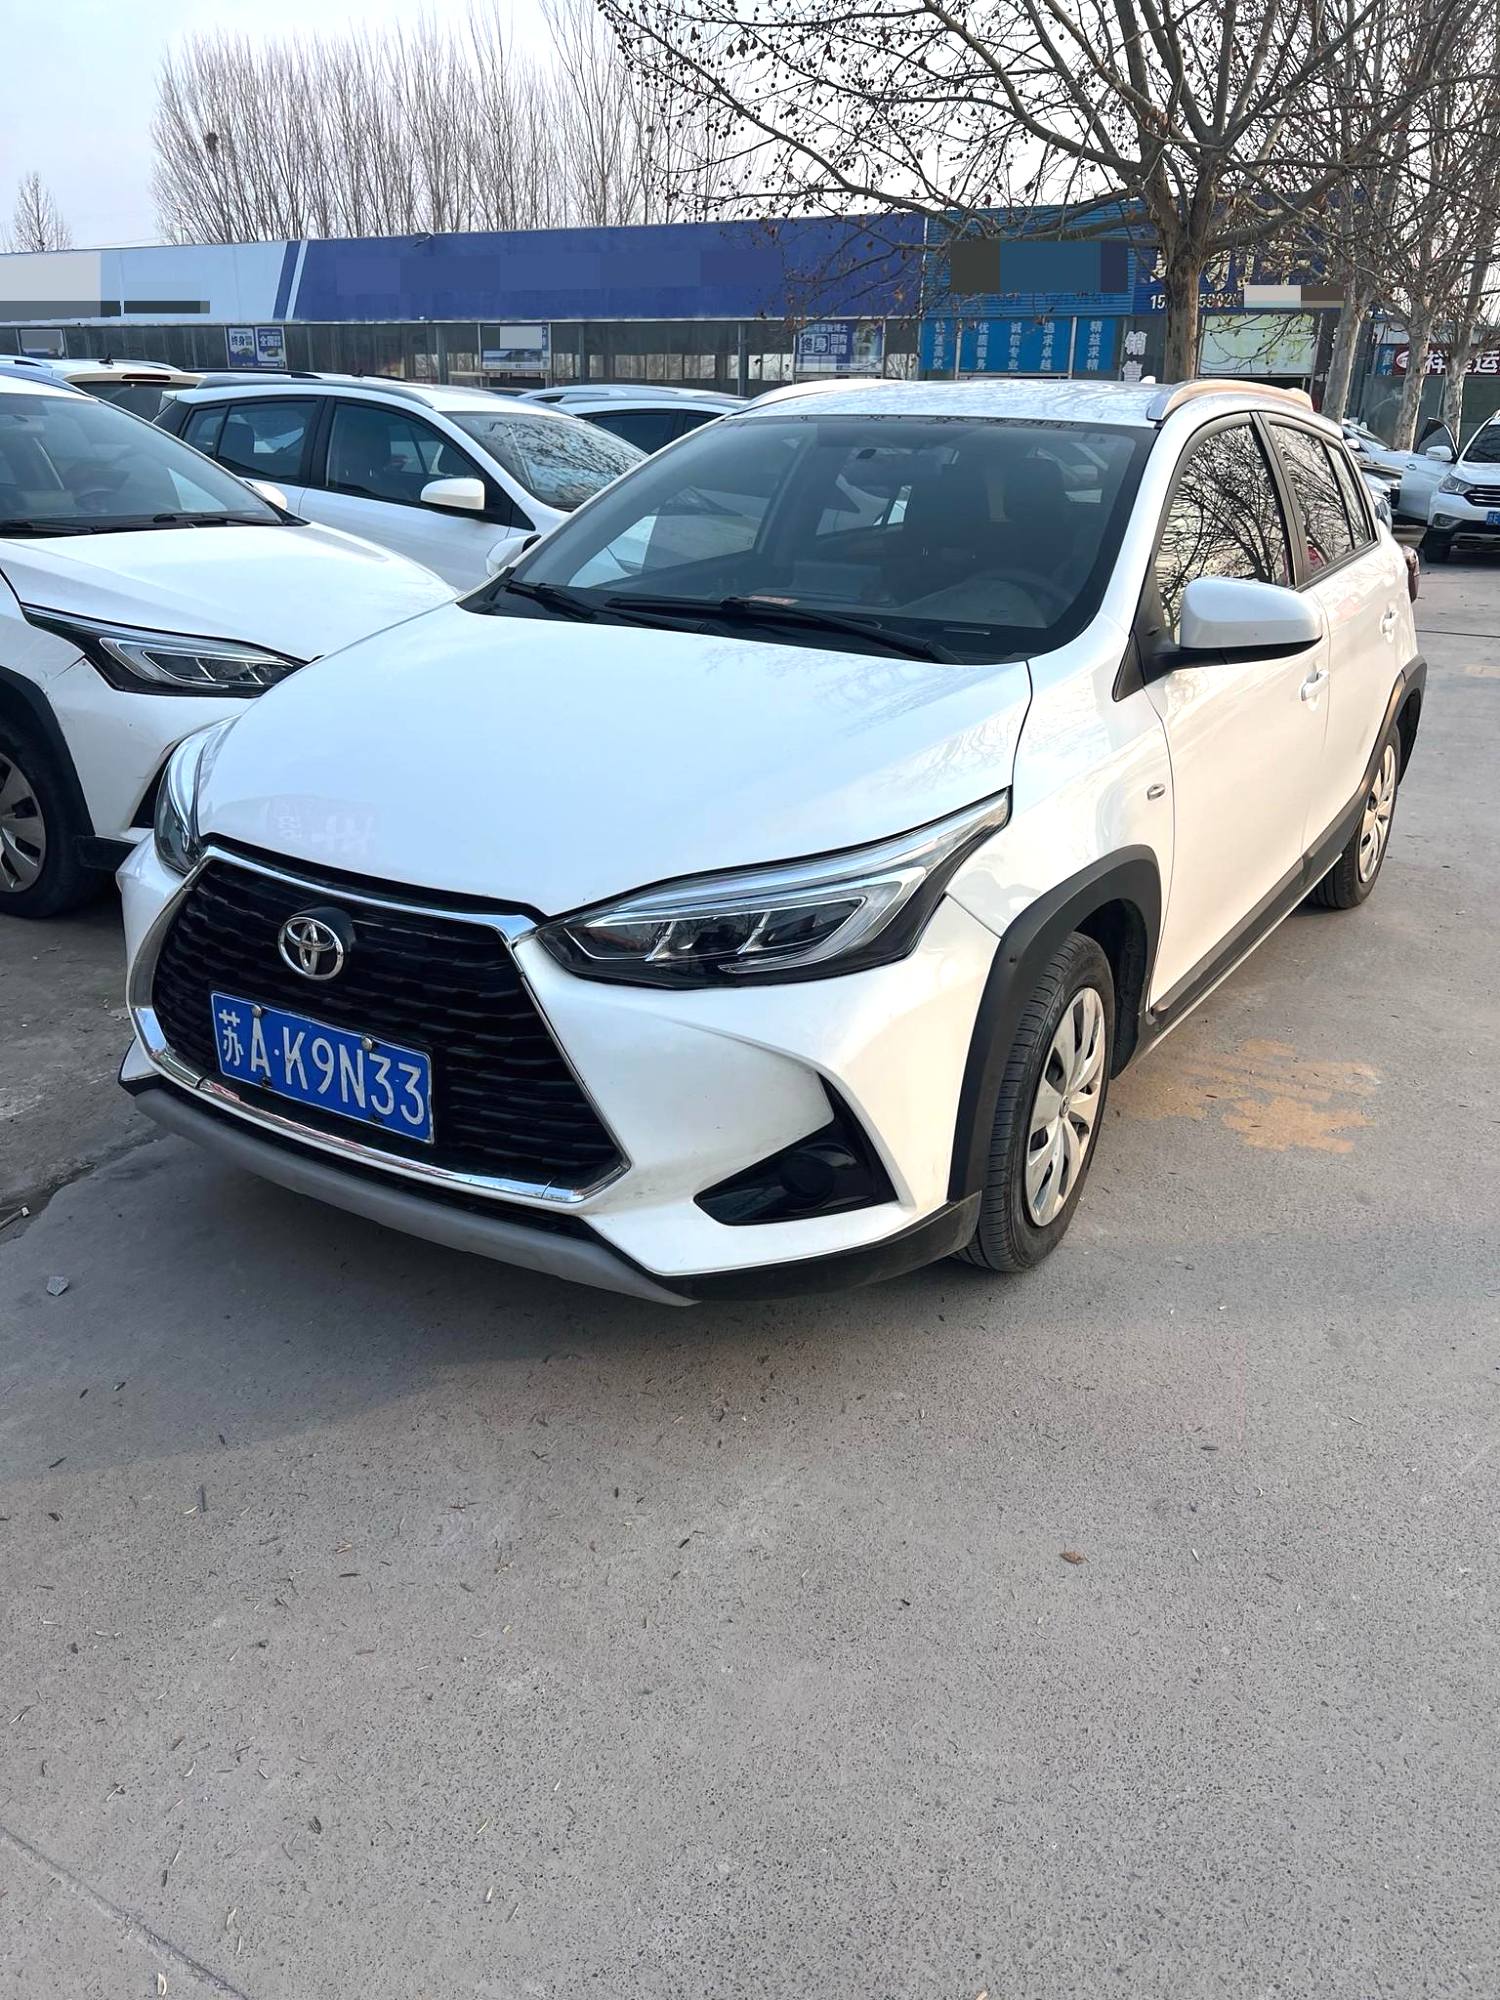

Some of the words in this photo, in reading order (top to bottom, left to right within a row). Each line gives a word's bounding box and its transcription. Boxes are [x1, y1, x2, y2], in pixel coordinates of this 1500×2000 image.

[976, 322, 990, 370] 优质服务
[1008, 322, 1022, 370] 诚信专业
[1040, 322, 1055, 370] 追求卓越
[1087, 321, 1103, 371] 精益求精
